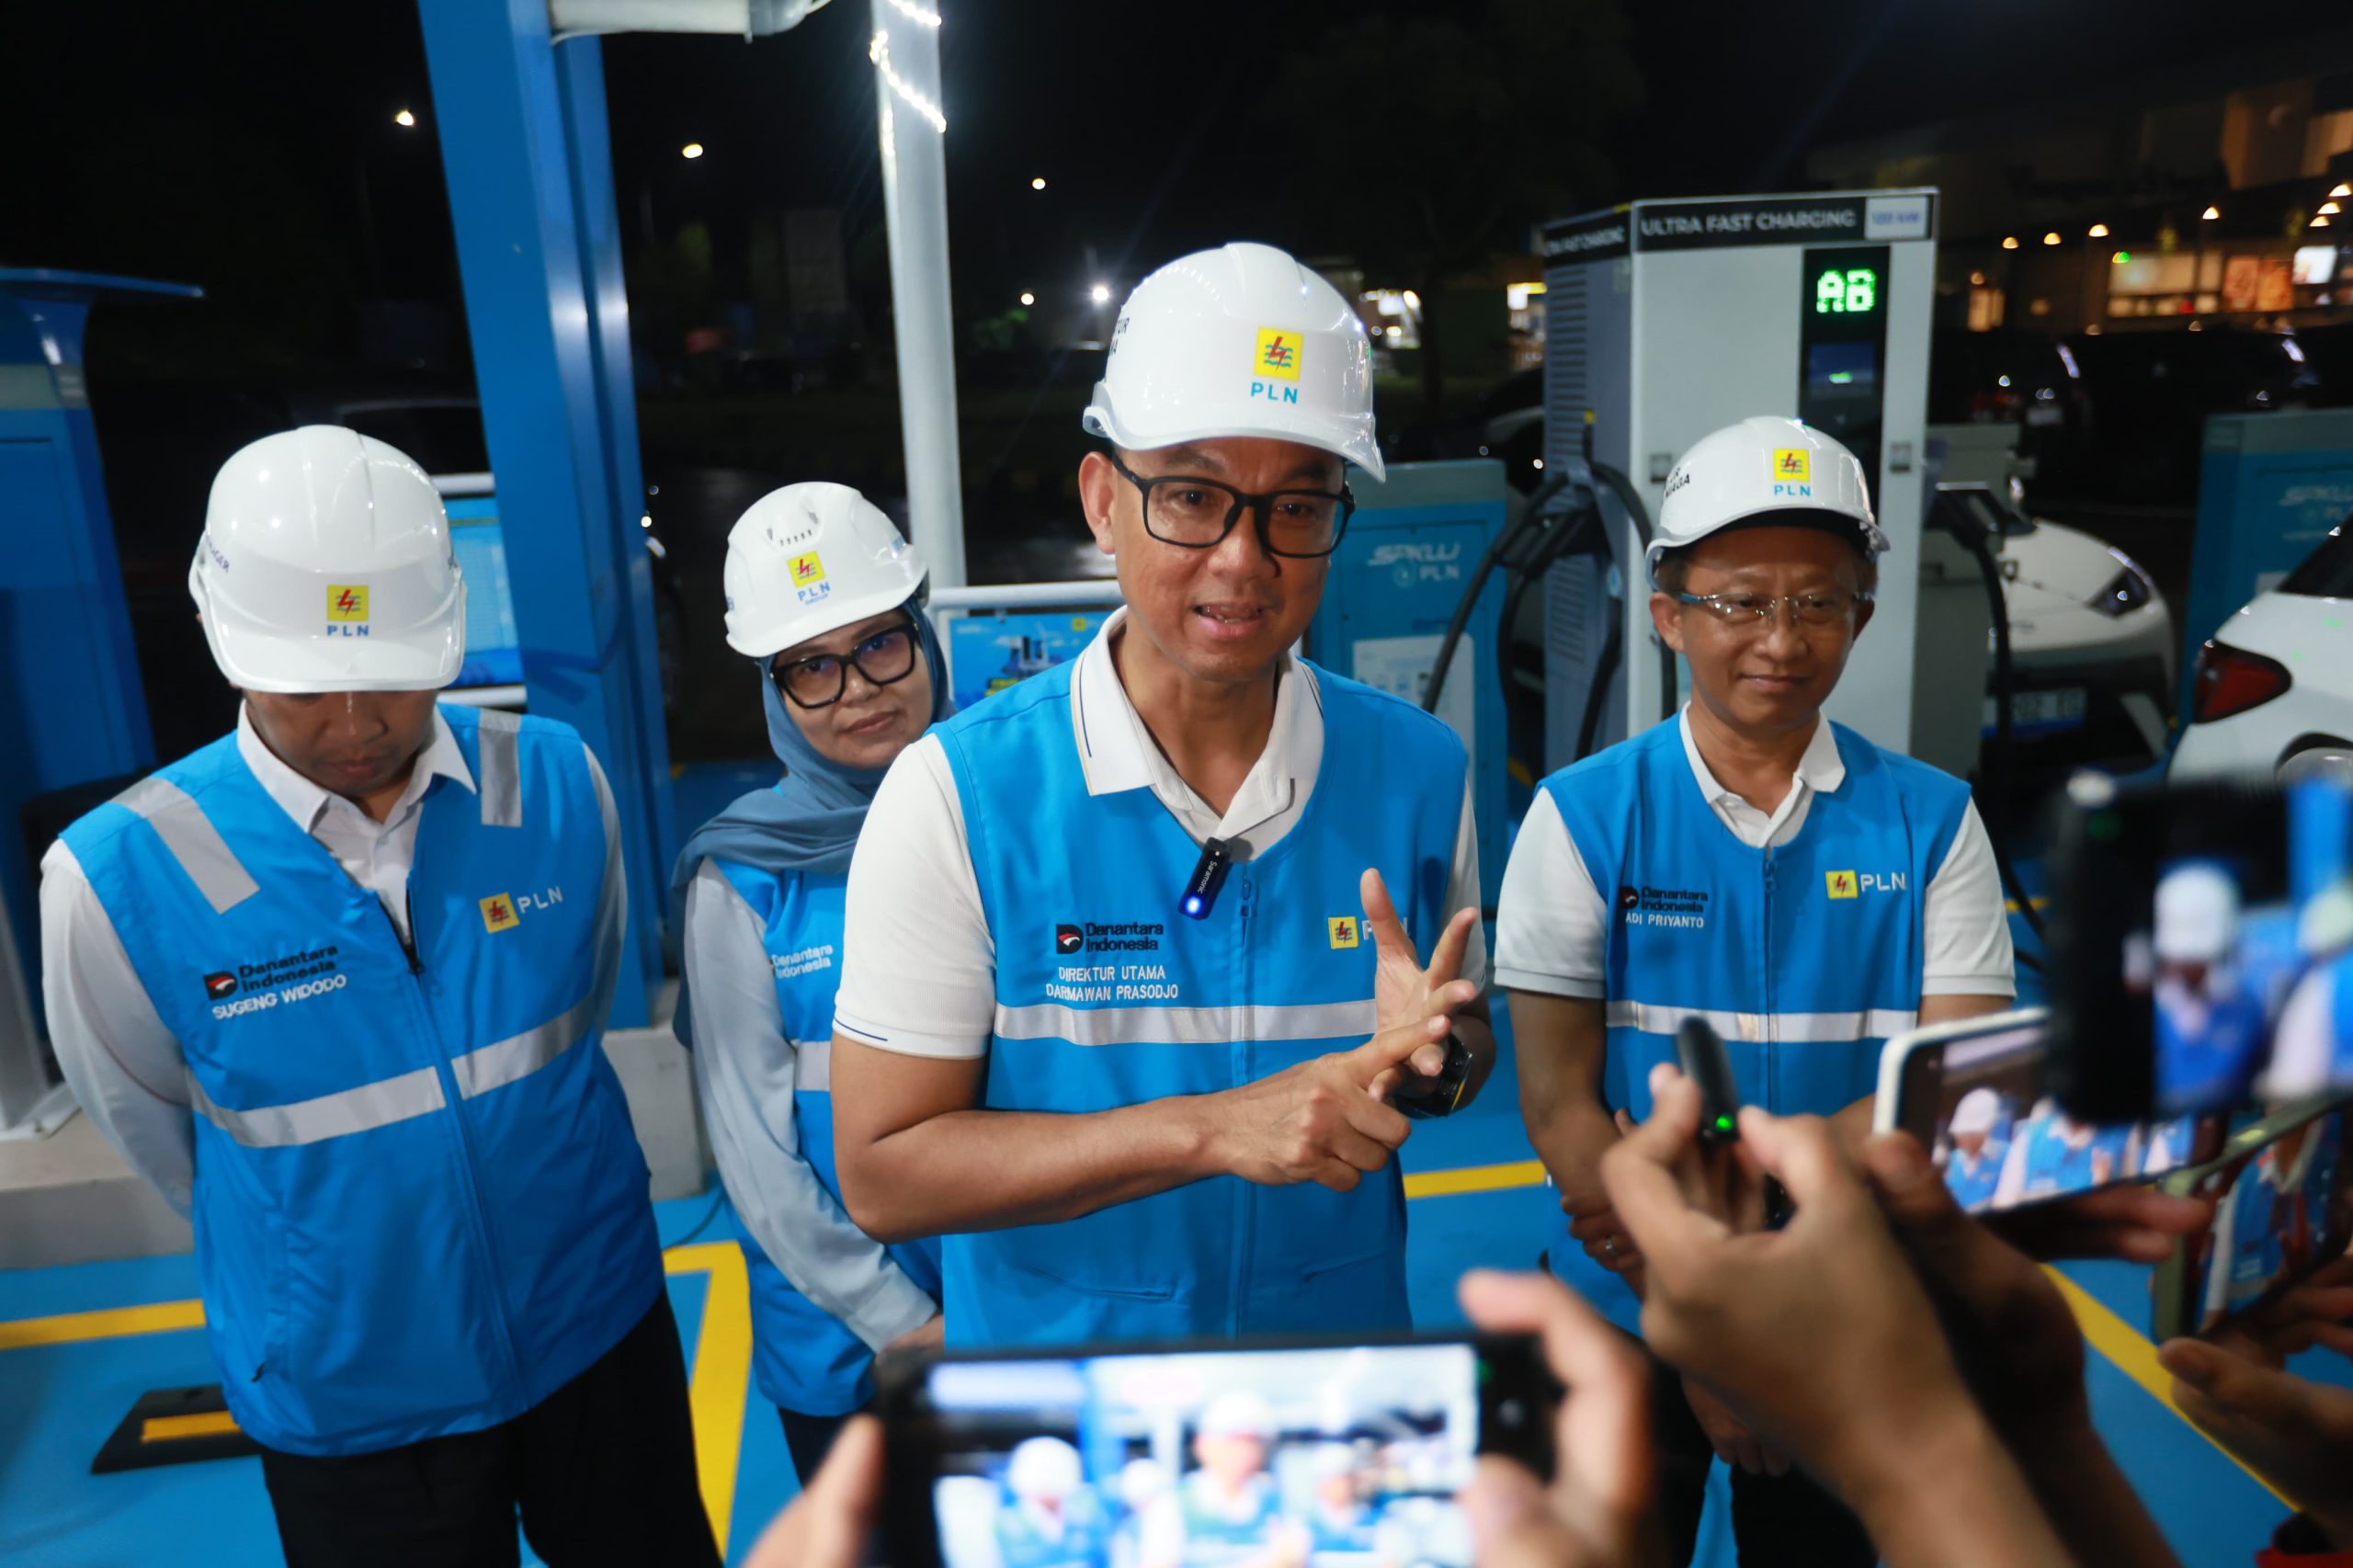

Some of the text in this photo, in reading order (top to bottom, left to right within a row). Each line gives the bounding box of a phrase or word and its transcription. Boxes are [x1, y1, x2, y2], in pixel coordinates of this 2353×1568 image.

[1641, 210, 1857, 236] ULTRA FAST CHARGING
[1251, 381, 1297, 404] PLN
[1774, 484, 1811, 497] PLN
[798, 582, 831, 601] PLN
[327, 624, 369, 637] PLN
[1198, 860, 1218, 893] Saramonic
[1860, 871, 1907, 892] PLN
[517, 886, 563, 914] PLN
[1642, 886, 1709, 902] Danantara
[1642, 898, 1704, 913] Indonesia
[1086, 922, 1164, 937] Danantara
[1625, 912, 1704, 928] ADI PRIYANTO
[1086, 937, 1158, 952] Indonesia
[238, 946, 338, 979] Danantara
[242, 960, 336, 993] Indonesia
[1059, 965, 1166, 982] DIREKTUR UTAMA
[212, 974, 347, 1020] SUGENG WIDODO
[1046, 983, 1179, 1002] DARMAWAN PRASODJO
